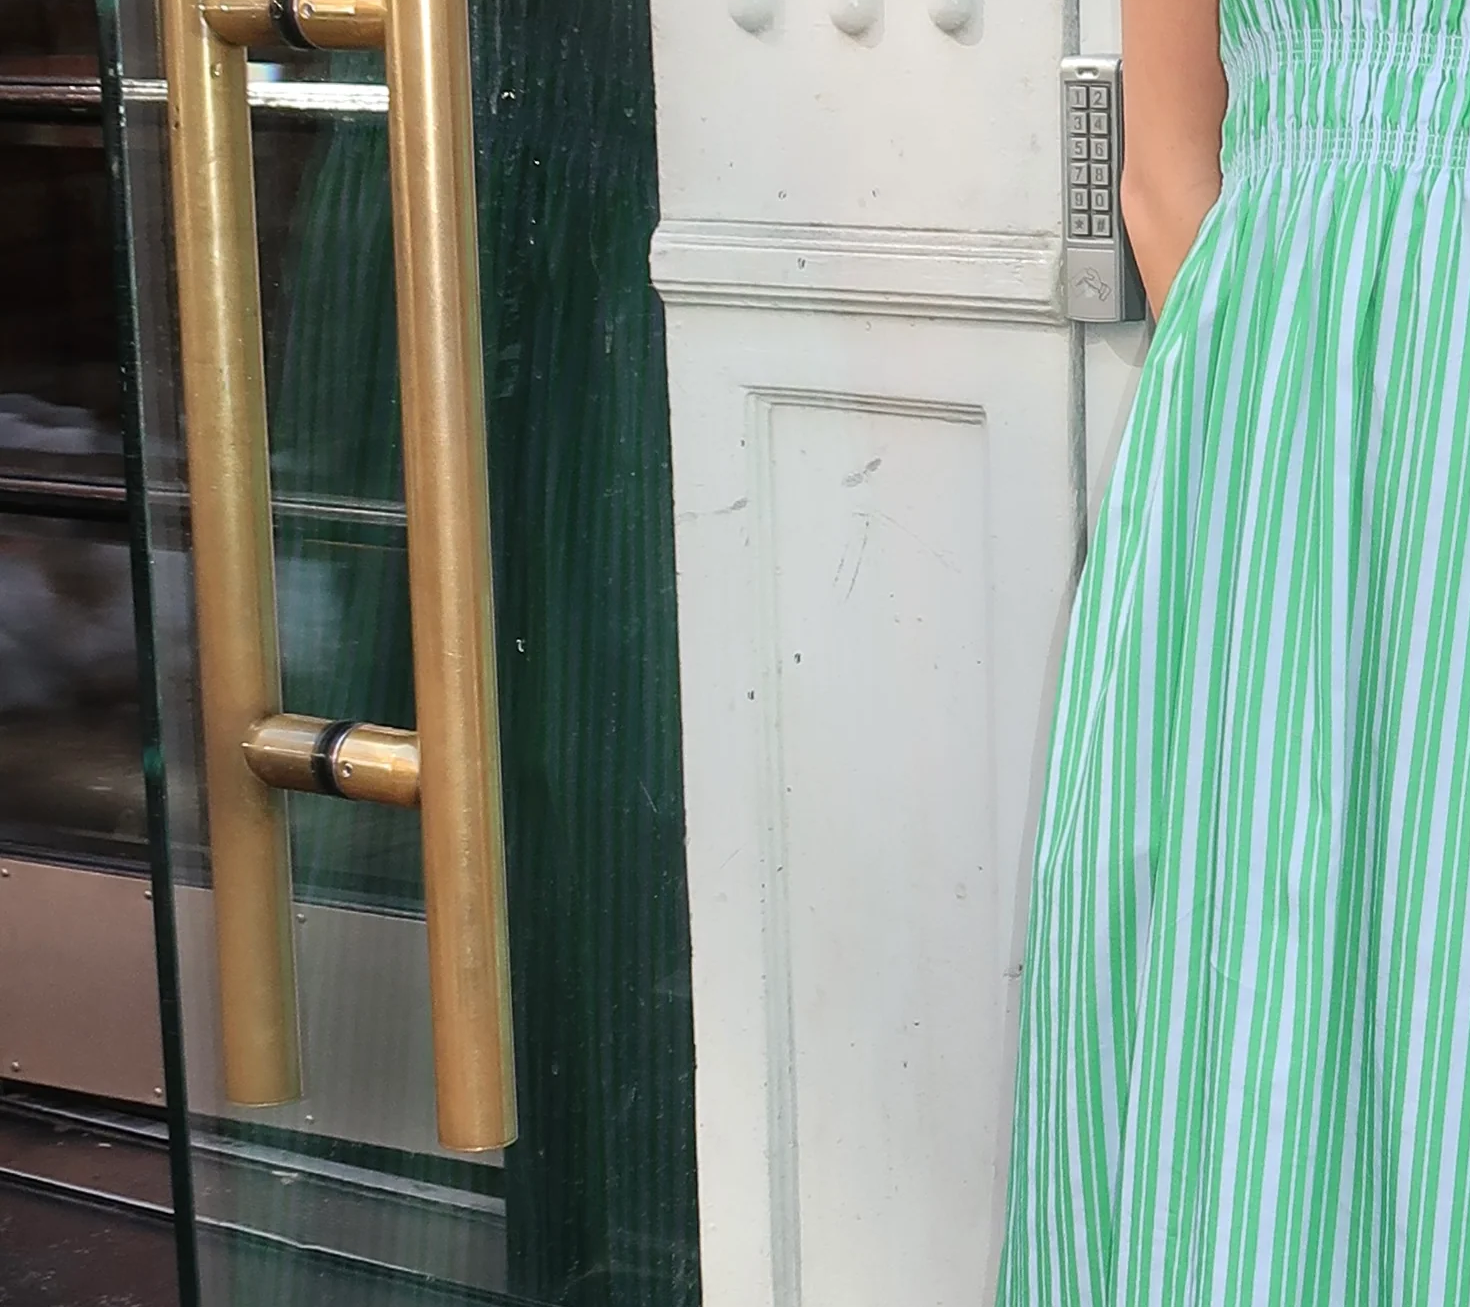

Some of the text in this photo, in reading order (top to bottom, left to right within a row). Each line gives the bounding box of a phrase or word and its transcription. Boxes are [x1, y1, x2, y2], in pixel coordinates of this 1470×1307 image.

[1074, 90, 1102, 106] 1 2
[1074, 116, 1102, 131] 3 4
[1074, 141, 1104, 157] 5 6
[1074, 166, 1104, 182] 7 8
[1075, 192, 1104, 207] 9 0
